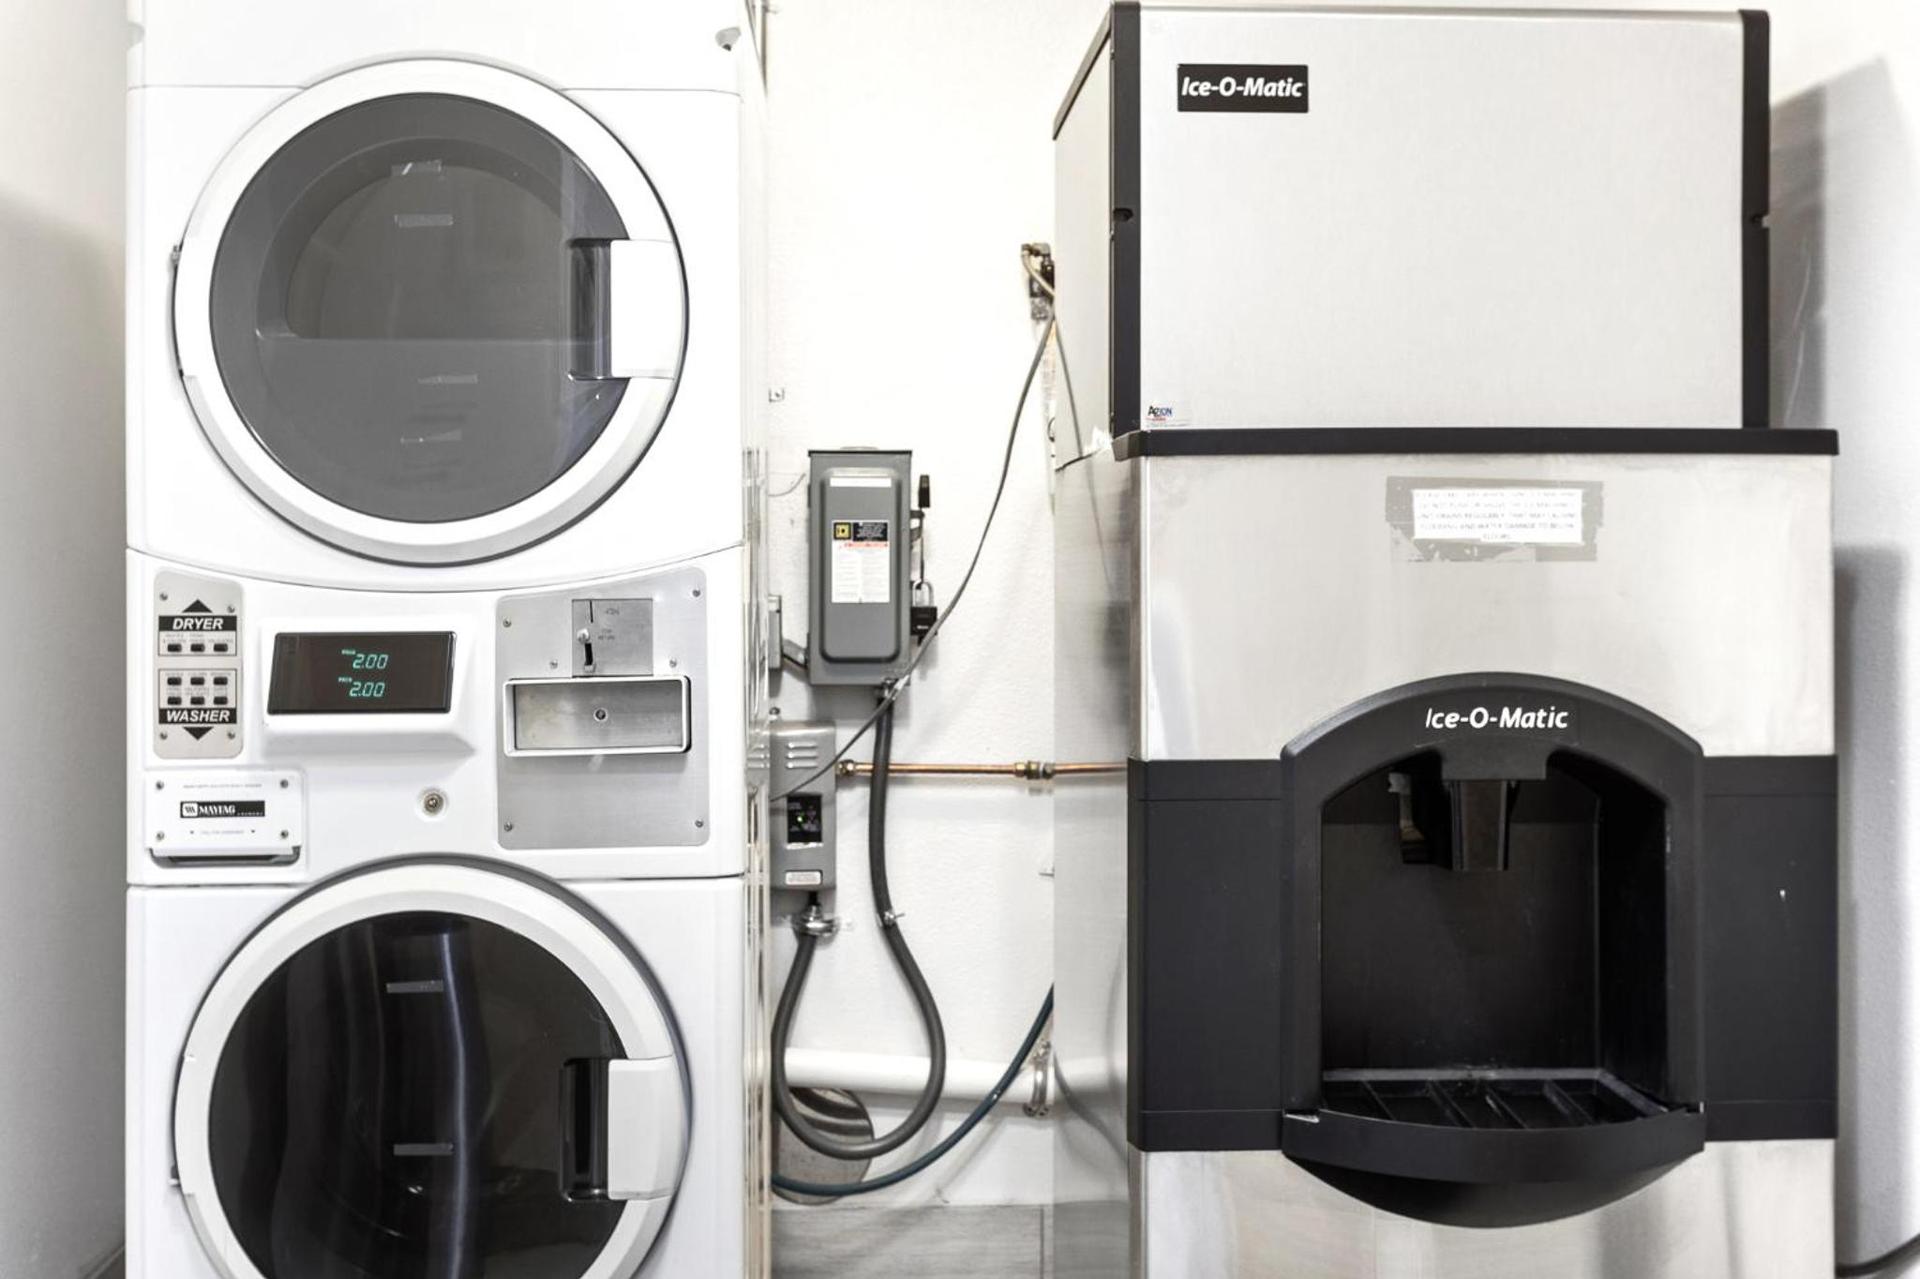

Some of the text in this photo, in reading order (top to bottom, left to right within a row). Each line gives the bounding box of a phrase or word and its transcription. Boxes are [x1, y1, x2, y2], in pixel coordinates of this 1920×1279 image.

[1181, 76, 1304, 98] Ice-O-Matic
[172, 617, 224, 631] DRYER
[352, 653, 389, 670] 2.00
[349, 681, 386, 697] 2.00
[166, 709, 230, 723] WASHER
[1425, 706, 1569, 729] Ice-O-Matic
[198, 805, 236, 816] MAYTAG
